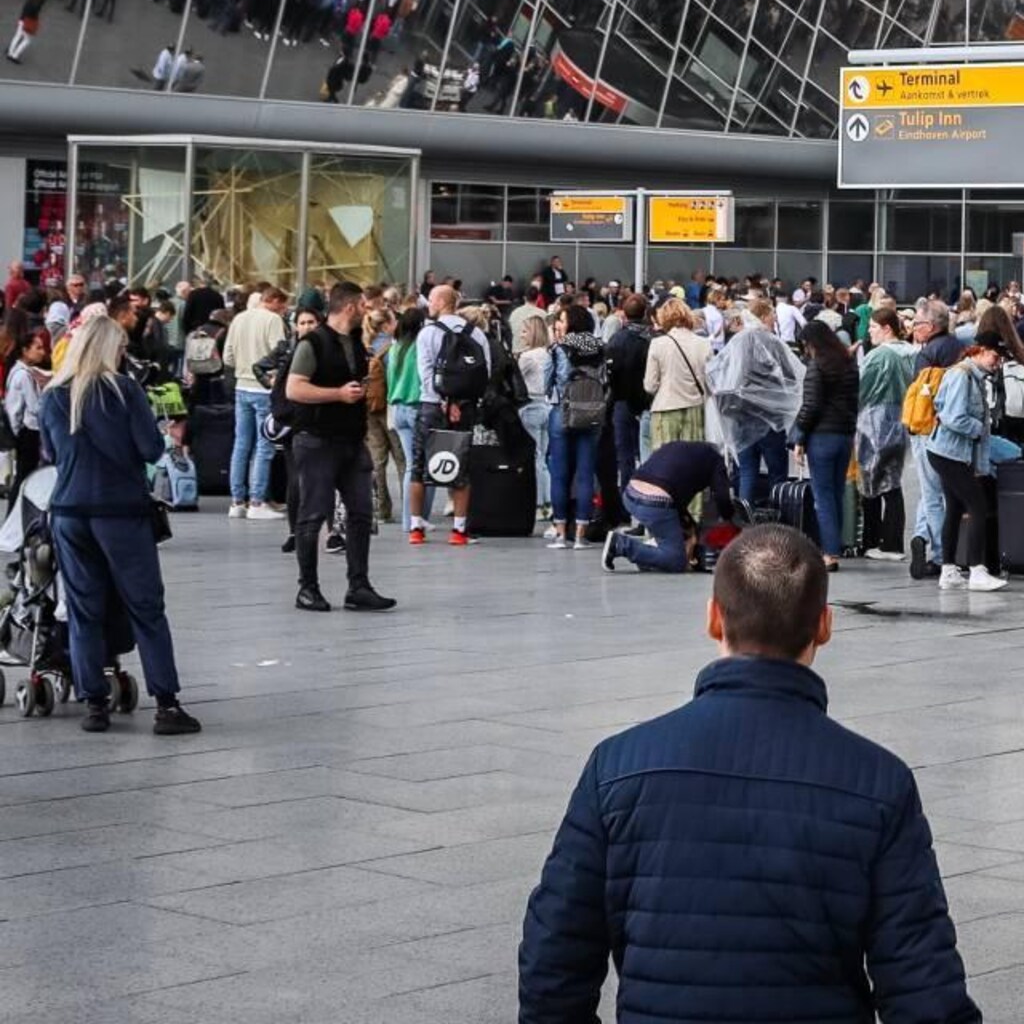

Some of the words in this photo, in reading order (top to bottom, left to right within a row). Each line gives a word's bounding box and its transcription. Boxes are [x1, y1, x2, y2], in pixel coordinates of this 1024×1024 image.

[899, 70, 960, 86] Terminal
[900, 91, 945, 100] Aankomst
[948, 91, 955, 100] &
[957, 90, 989, 100] vertrek
[899, 111, 934, 128] Tulip
[939, 111, 962, 125] Inn
[899, 130, 949, 141] Eindhoven
[951, 129, 986, 142] Airport
[433, 459, 456, 474] JD
